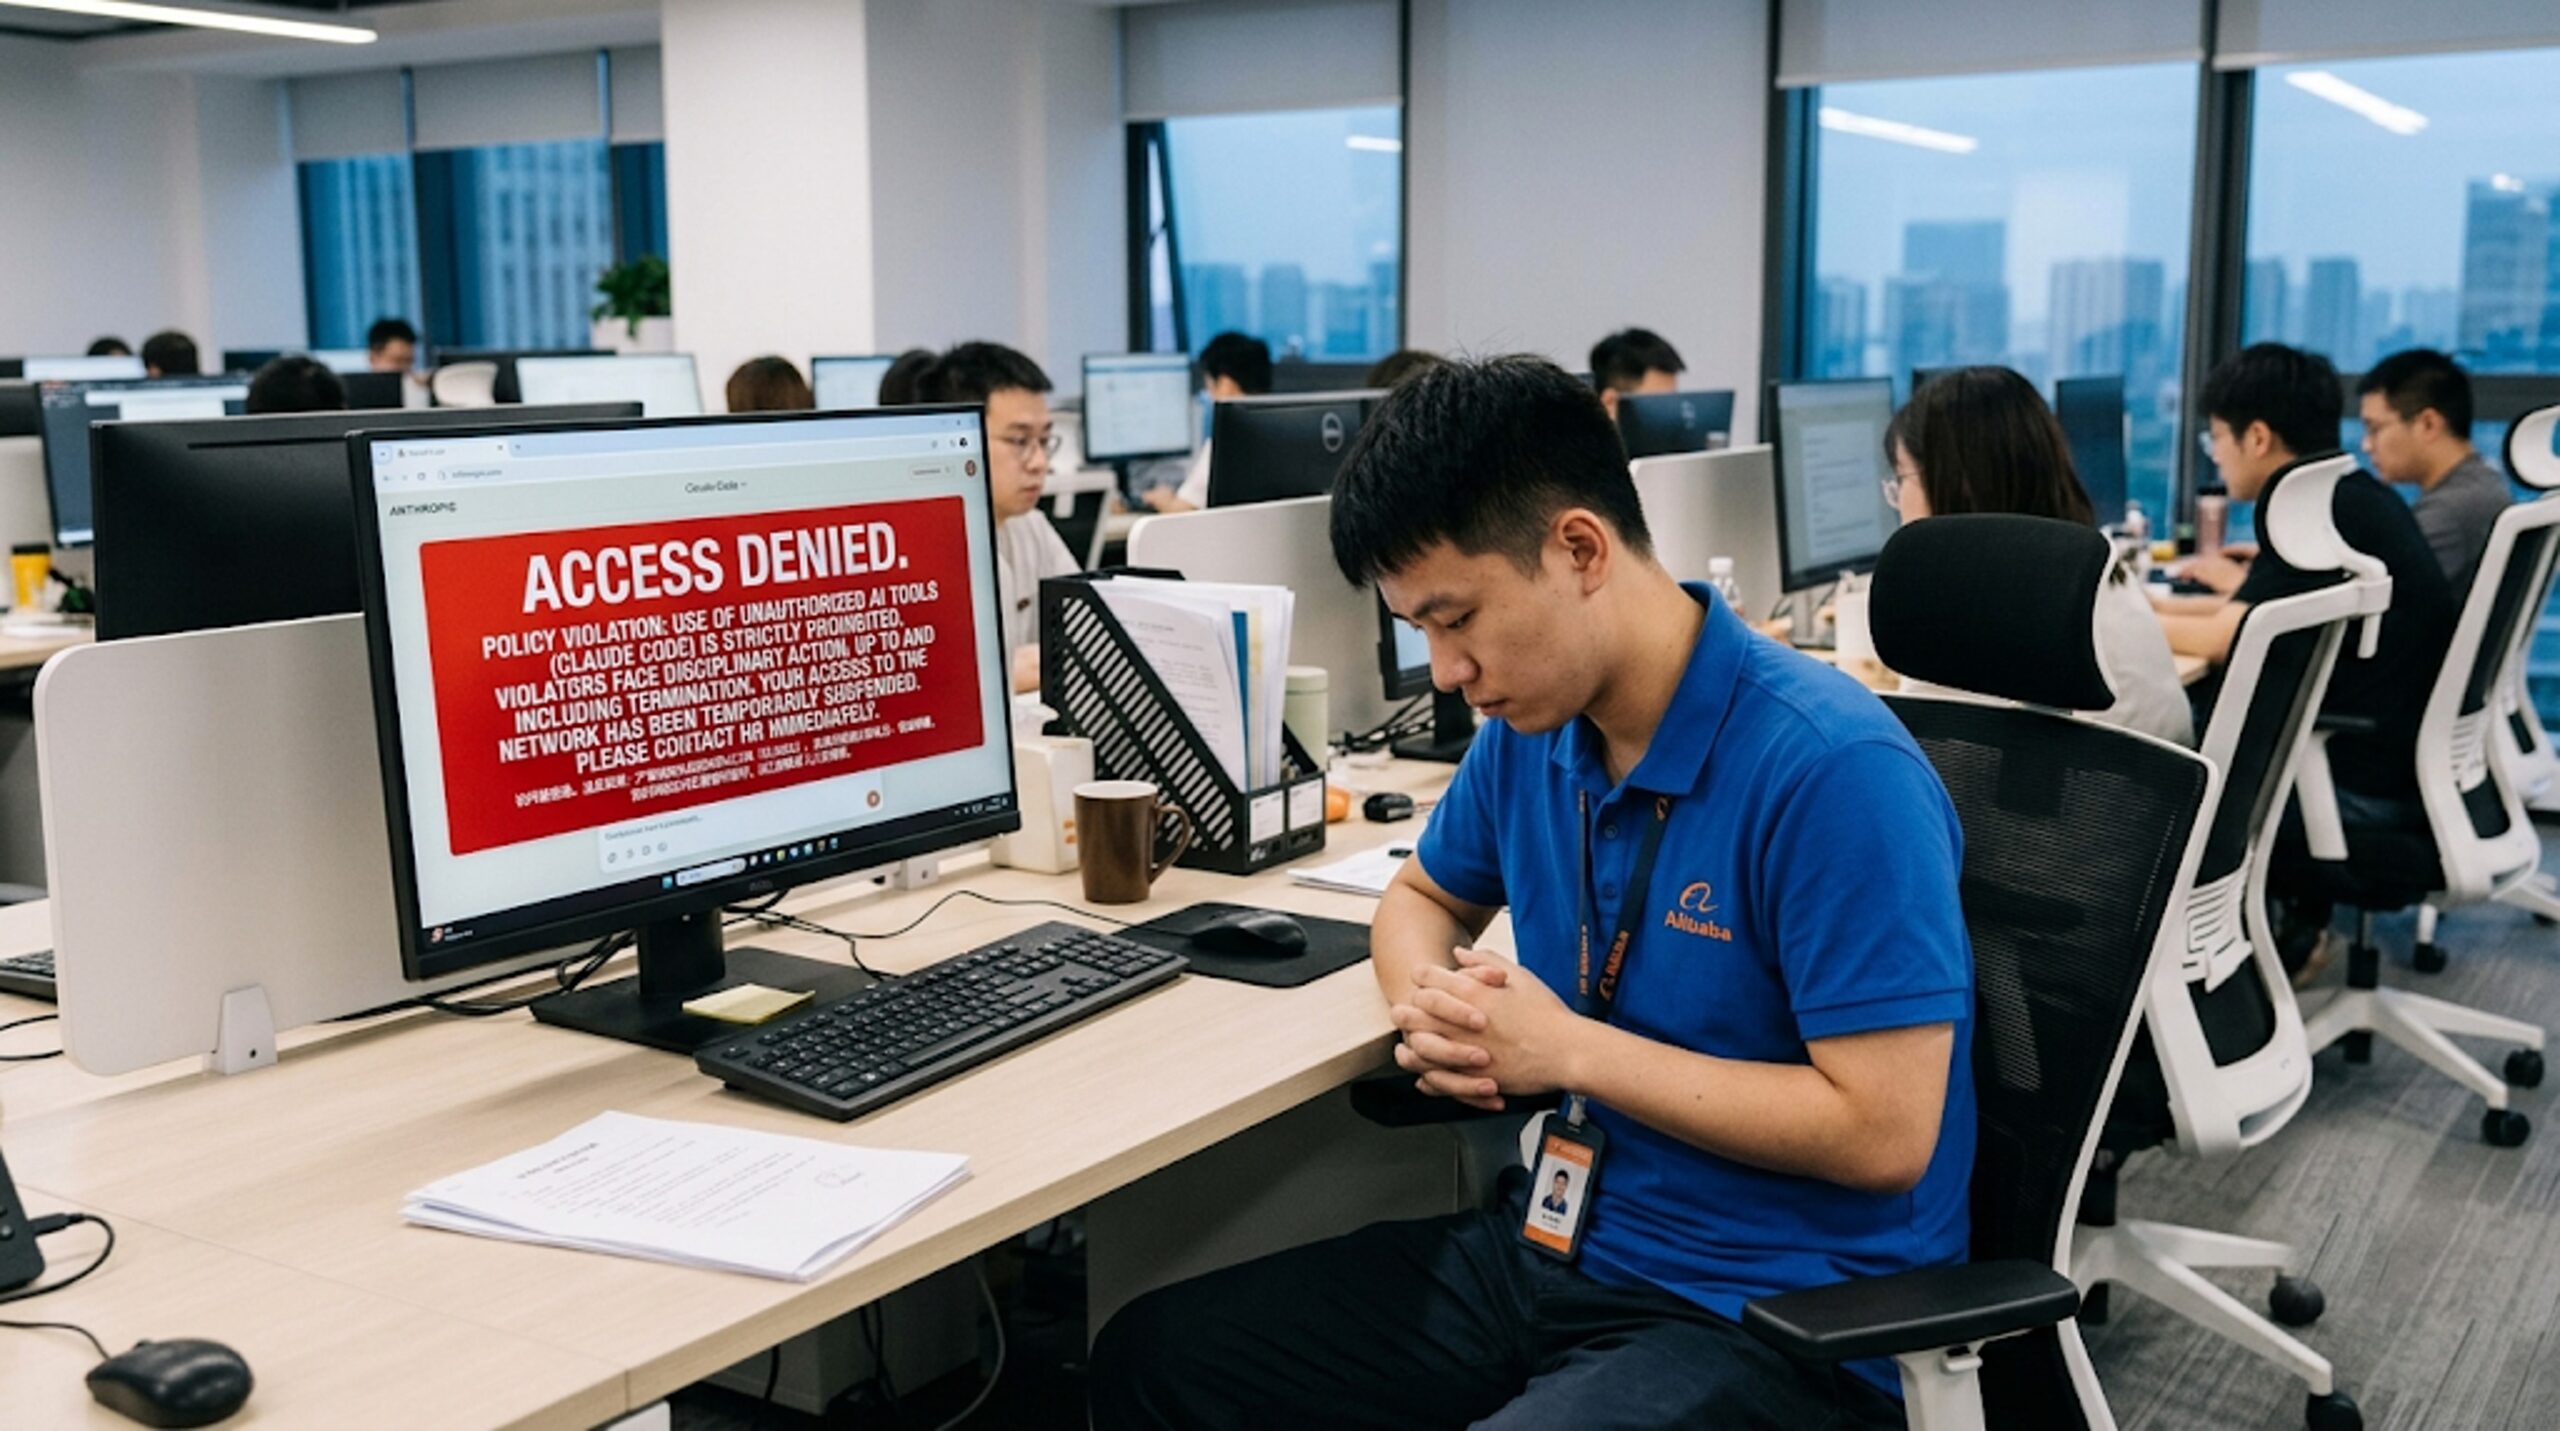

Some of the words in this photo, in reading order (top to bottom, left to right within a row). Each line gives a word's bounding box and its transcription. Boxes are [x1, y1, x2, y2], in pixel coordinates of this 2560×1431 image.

[523, 537, 724, 613] ACCESS
[737, 521, 909, 587] DENIED.
[482, 629, 556, 659] POLICY
[561, 616, 668, 650] VIOLATION:
[671, 610, 709, 634] USE
[712, 606, 735, 629] OF
[870, 588, 886, 607] AI
[889, 580, 939, 605] TOOLS
[550, 643, 635, 679] (CLAUDE
[701, 633, 718, 655] IS
[722, 621, 801, 650] STRICTLY
[515, 696, 623, 734] INCLUDING
[874, 654, 894, 674] TO
[899, 649, 928, 670] THE
[612, 665, 660, 692] FACE
[663, 647, 784, 685] DISCIPLINARY
[854, 634, 876, 655] UP
[878, 630, 899, 651] TO
[903, 625, 935, 646] AND
[498, 725, 601, 763] NETWORK
[605, 717, 643, 744] HAS
[649, 709, 697, 736] BEEN
[576, 742, 650, 774] PLEASE
[739, 720, 764, 745] HR
